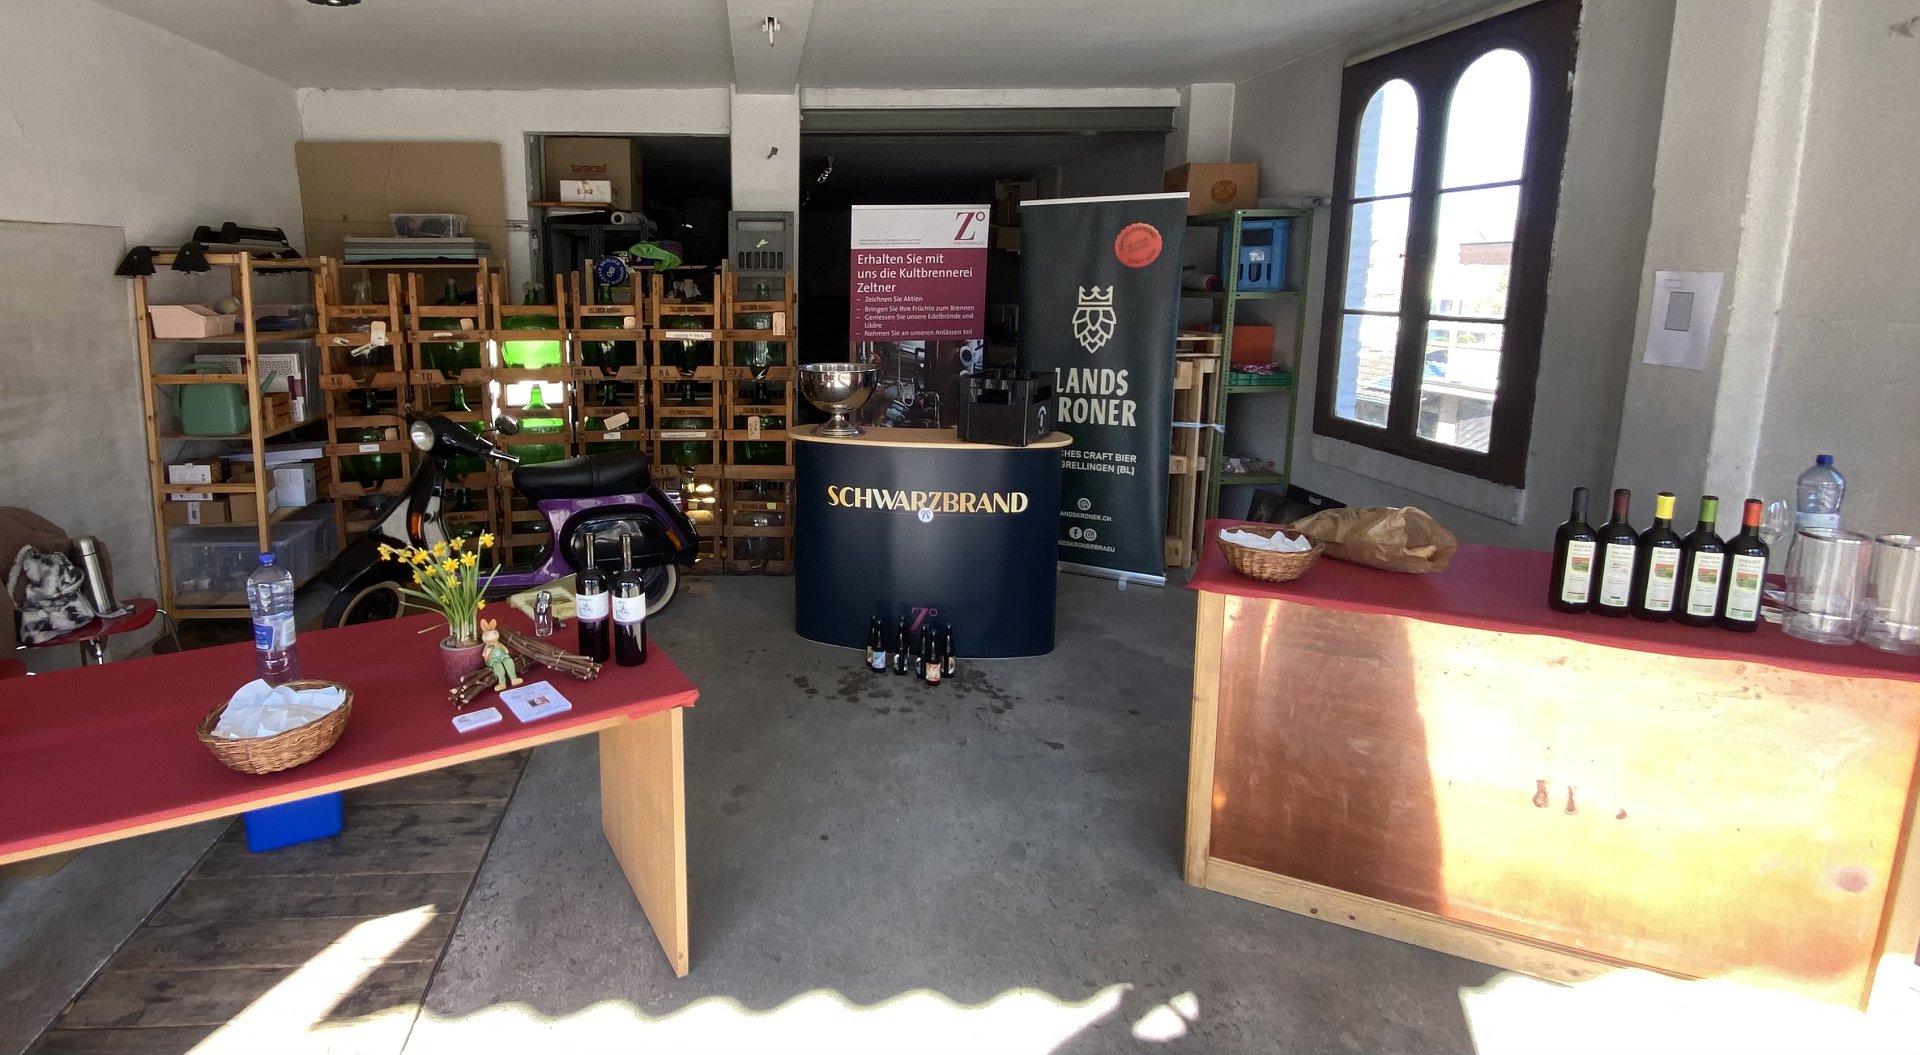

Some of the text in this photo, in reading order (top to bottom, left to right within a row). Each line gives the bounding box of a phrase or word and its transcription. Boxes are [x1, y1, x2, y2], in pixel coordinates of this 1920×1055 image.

[857, 253, 944, 264] Erhalten Sie mit
[857, 267, 973, 279] uns die Kultbrennerei
[857, 282, 896, 293] Zeltner
[331, 377, 343, 386] 16
[421, 372, 432, 381] 10
[1055, 367, 1129, 397] LANDS
[1057, 396, 1137, 427] RONER
[1083, 451, 1114, 461] CRAFT
[1115, 453, 1137, 463] BIER
[827, 485, 1029, 514] SCHWARZBRAND
[1059, 511, 1112, 522] ANDSKRONER.CH
